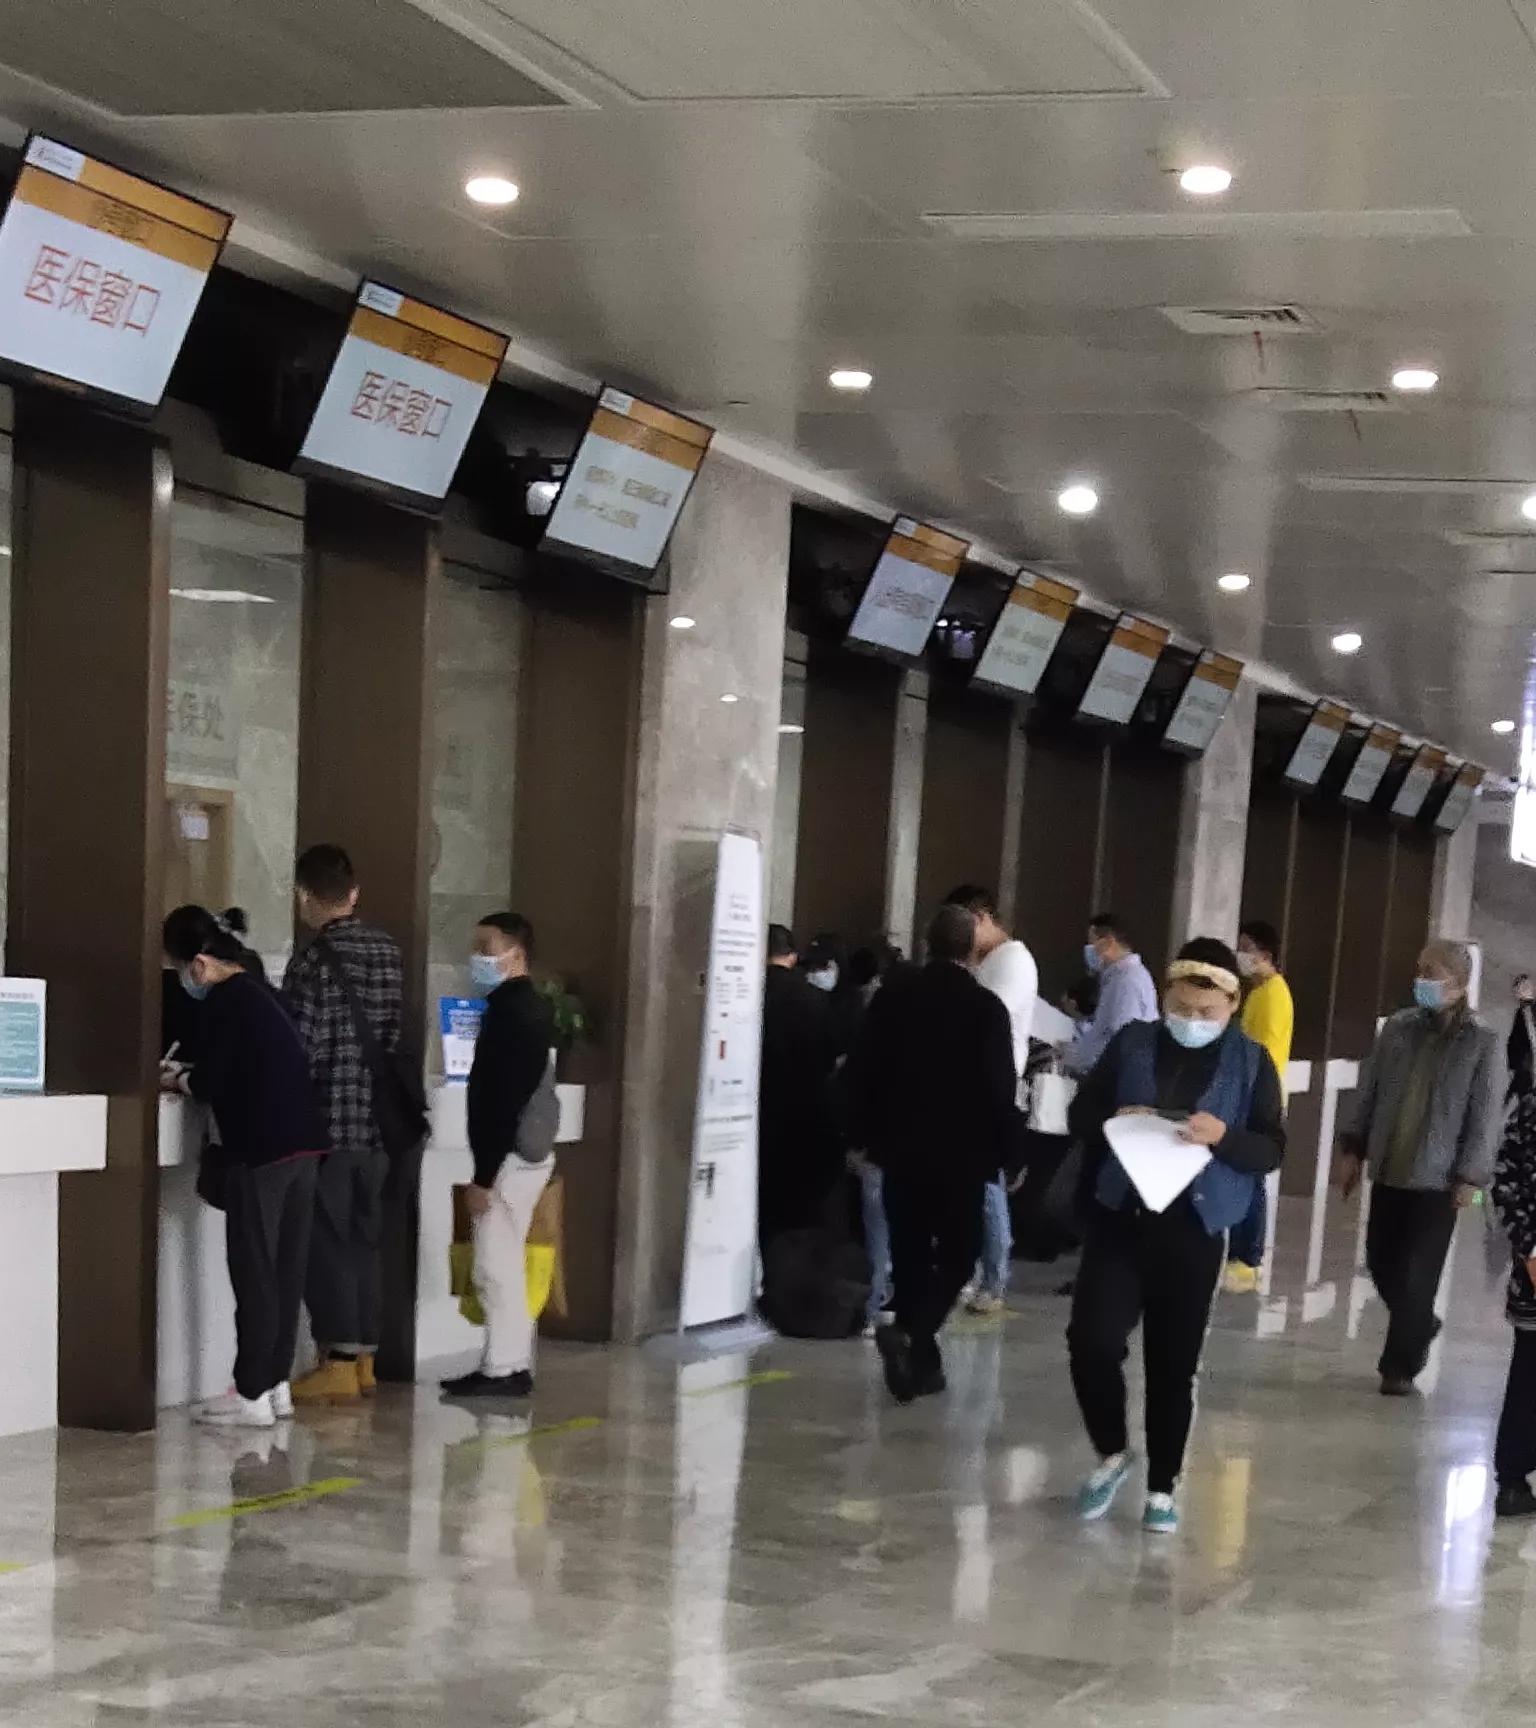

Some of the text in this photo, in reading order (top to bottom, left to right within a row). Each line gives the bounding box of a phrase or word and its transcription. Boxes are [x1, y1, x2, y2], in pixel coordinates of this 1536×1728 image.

[23, 244, 162, 338] 医保窗口
[351, 370, 453, 442] 医保窗口
